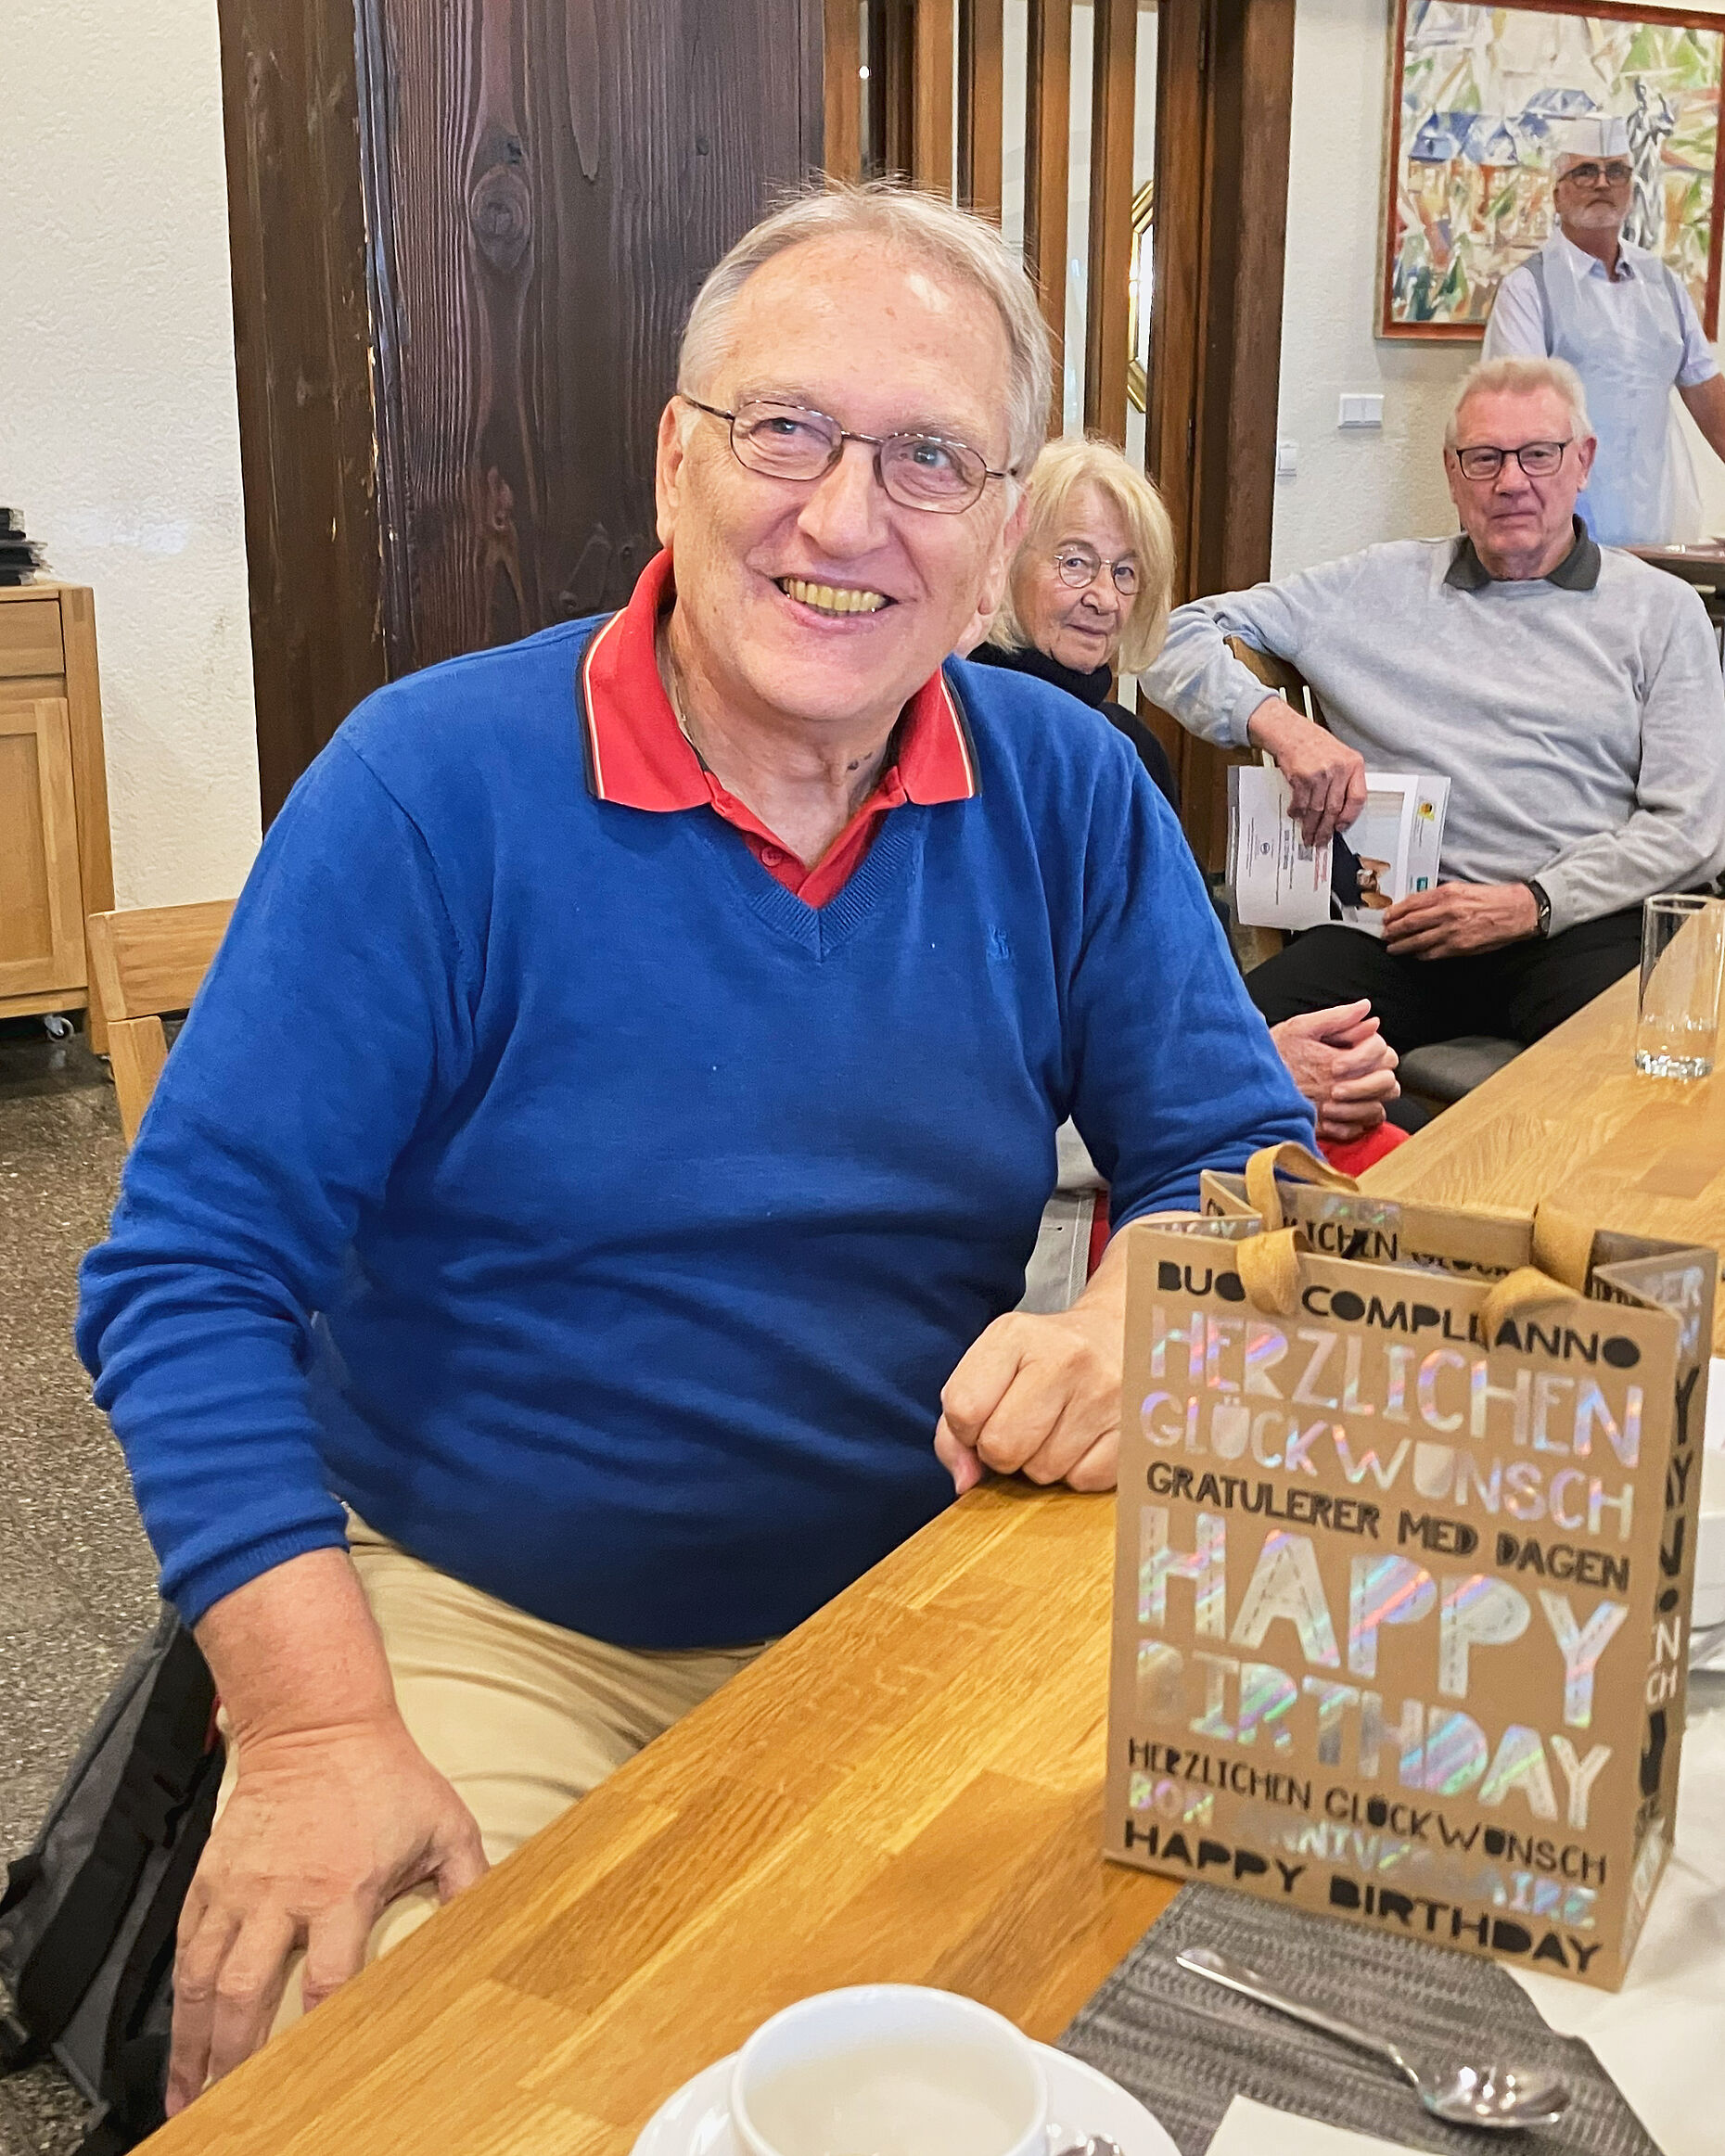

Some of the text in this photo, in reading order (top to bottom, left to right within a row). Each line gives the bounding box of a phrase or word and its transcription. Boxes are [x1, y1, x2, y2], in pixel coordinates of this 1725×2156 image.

[1157, 1259, 1246, 1302] BUO
[1150, 1305, 1643, 1469] HERZLICHEN
[1146, 1461, 1381, 1540] GRATULERER
[1398, 1511, 1479, 1556] MED
[1496, 1536, 1630, 1592] DAGEN
[1138, 1505, 1629, 1729] HAPPY
[1128, 1736, 1311, 1813] HERZLICHEN
[1129, 1769, 1215, 1828] BON
[1136, 1639, 1614, 1831] BIRTHDAY
[1123, 1818, 1604, 1973] HAPPY BIRTHDAY
